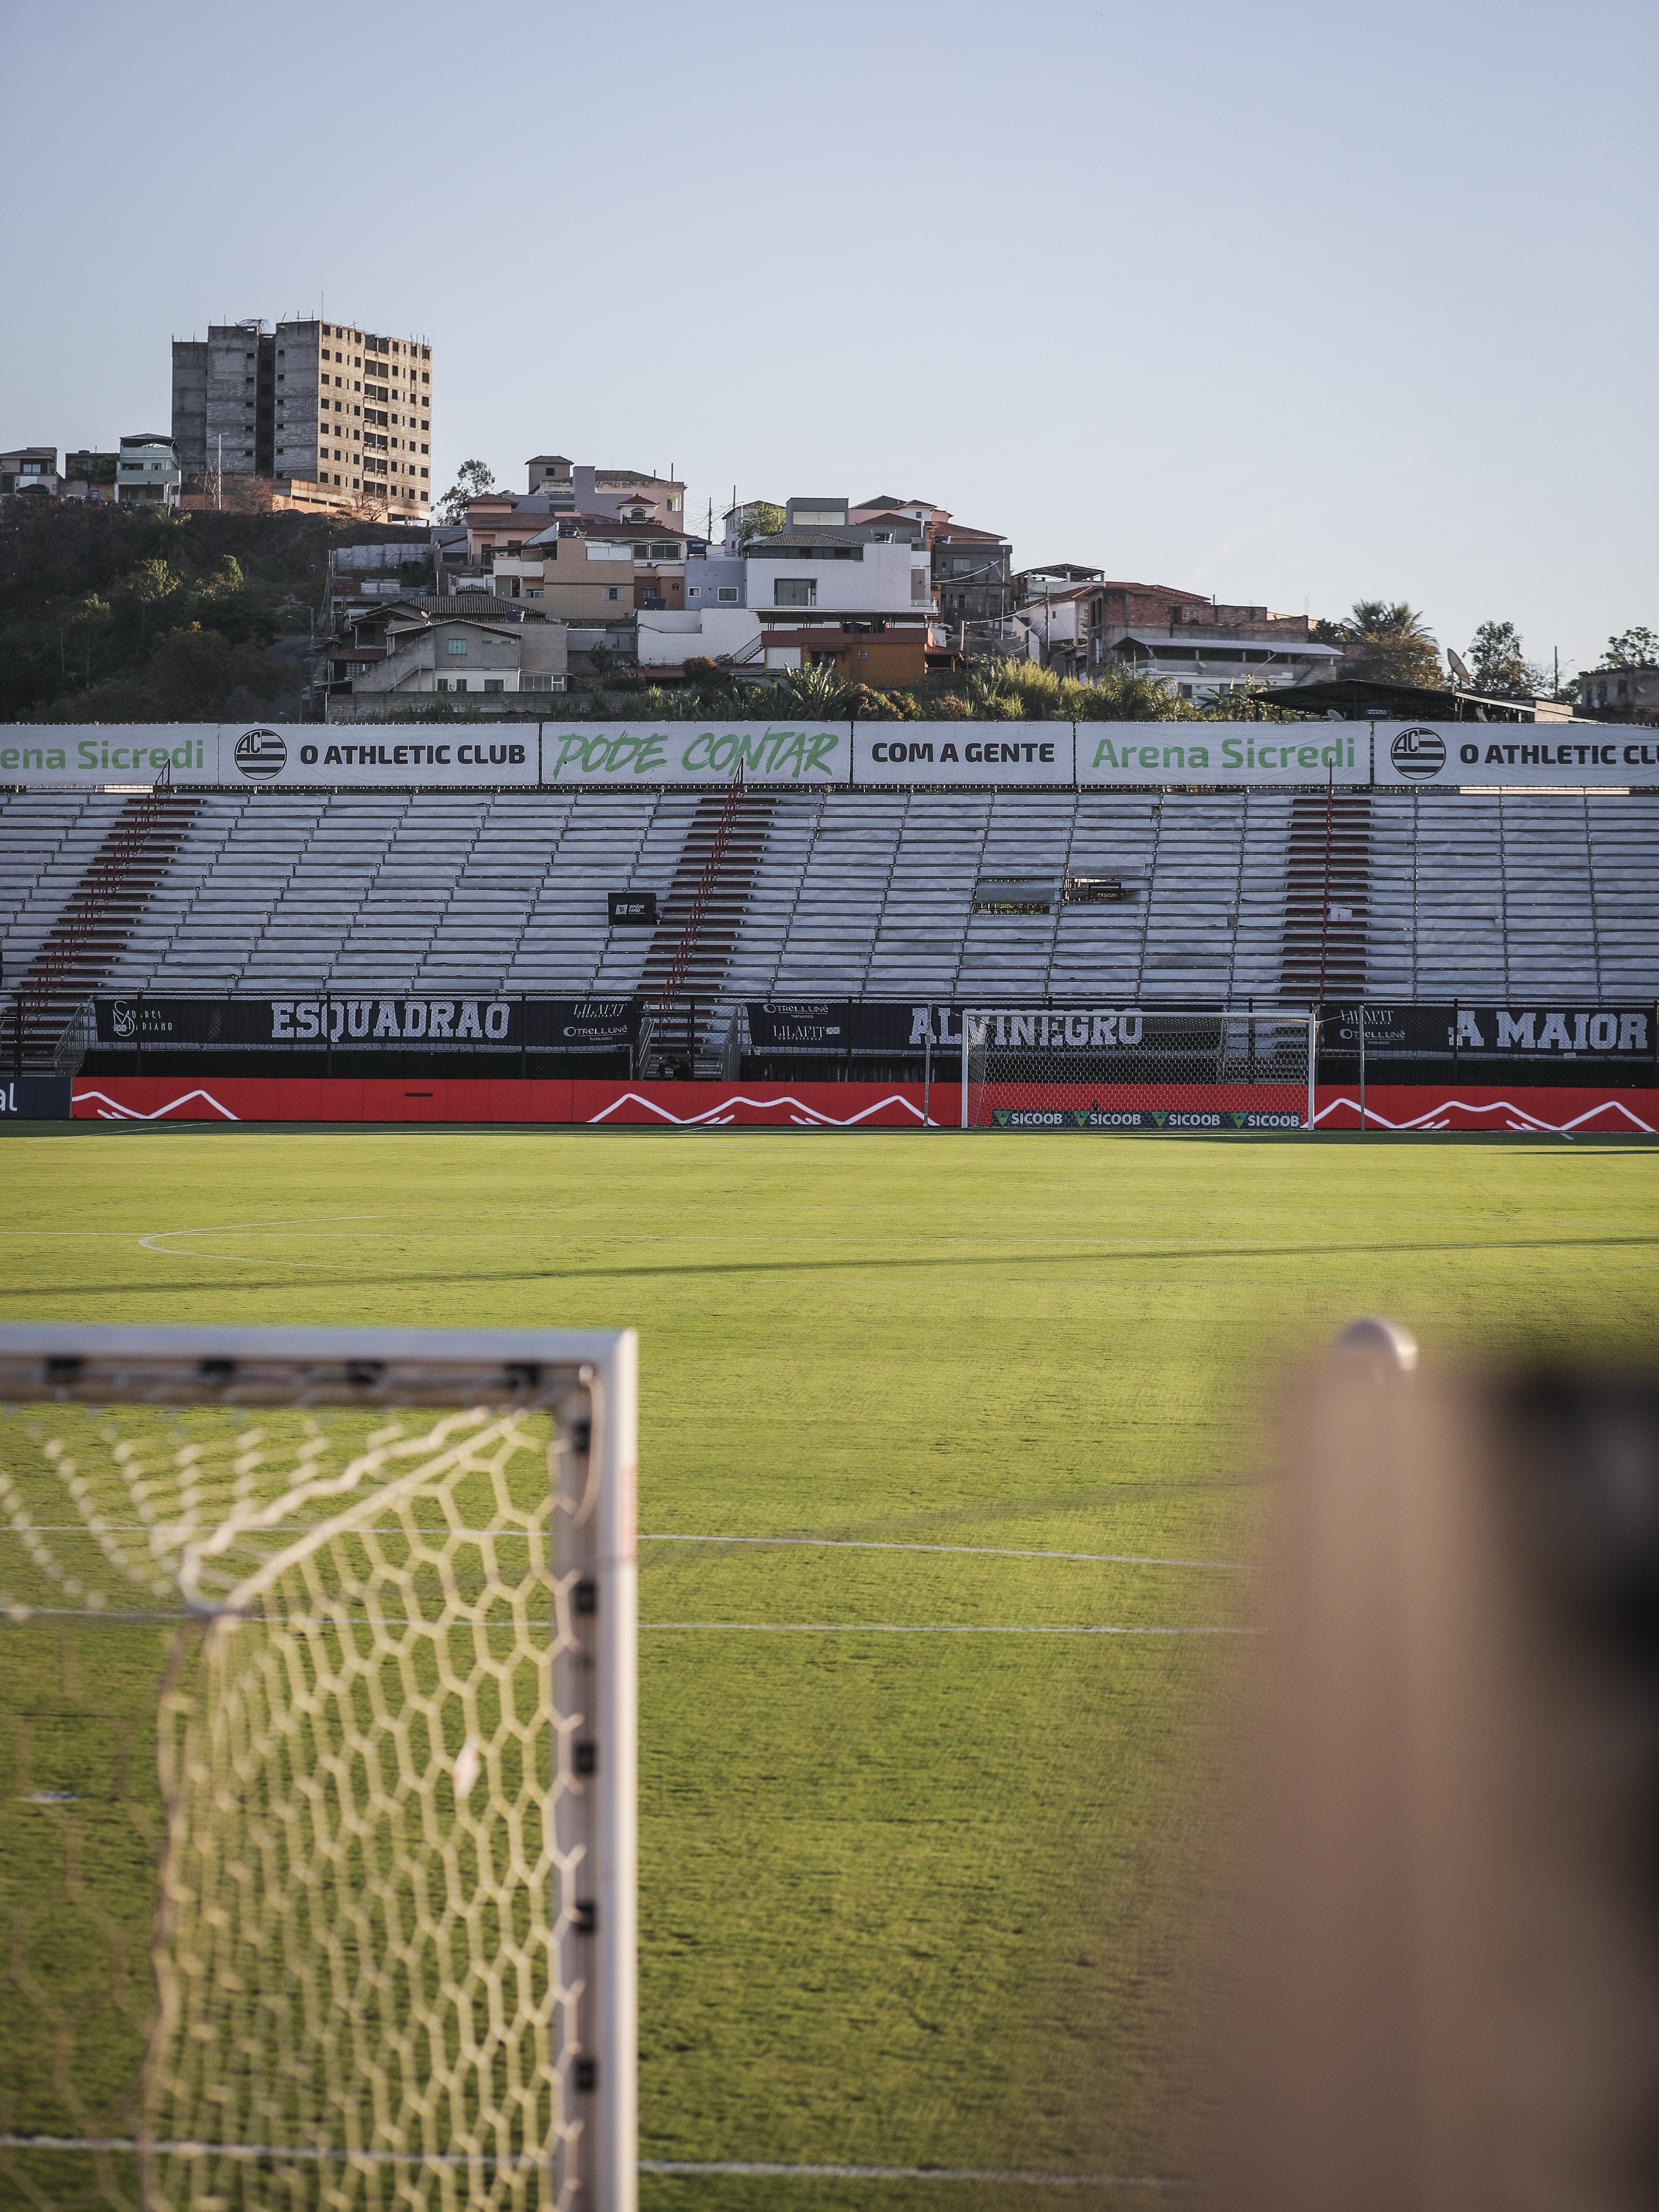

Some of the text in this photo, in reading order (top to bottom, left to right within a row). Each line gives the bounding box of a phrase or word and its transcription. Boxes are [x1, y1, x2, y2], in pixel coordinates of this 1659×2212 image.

[0, 739, 204, 770] ena Sicredi
[300, 744, 525, 765] O ATHLETIC CLUB
[553, 726, 839, 780] PODE CONTAR
[872, 743, 1055, 763] COM A GENTE
[1092, 738, 1355, 768] Arena Sicredi
[1460, 744, 1659, 765] O ATHLETIC CL
[271, 1001, 510, 1043] ESQUADRAO
[1496, 1011, 1648, 1049] MAIOR
[1011, 1113, 1063, 1124] SICOOB
[1090, 1114, 1141, 1125] SICOOB
[1169, 1114, 1220, 1125] SICOOB
[1247, 1115, 1299, 1127] SICOOB
